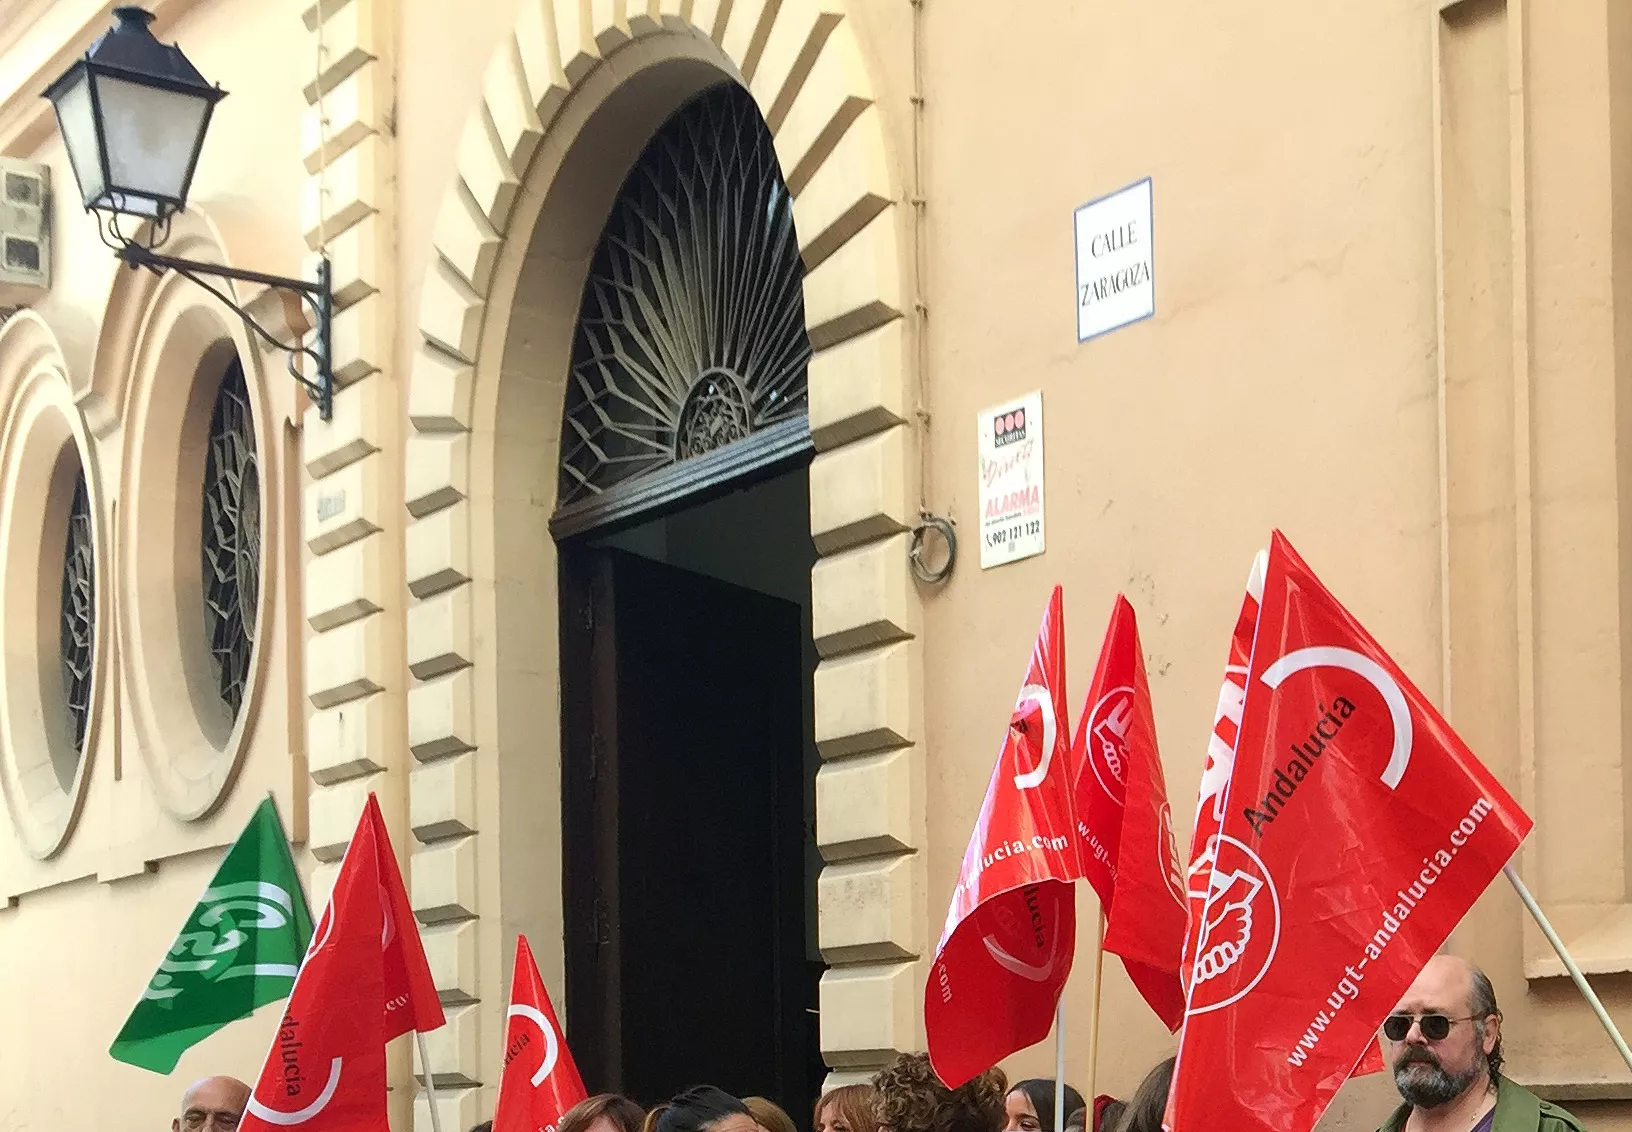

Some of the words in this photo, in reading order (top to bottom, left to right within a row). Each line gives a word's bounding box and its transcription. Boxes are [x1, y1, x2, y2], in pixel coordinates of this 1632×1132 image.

[1091, 220, 1138, 259] CALLE
[1080, 259, 1150, 307] ZARAGOZA
[986, 485, 1040, 519] ALARMA
[992, 531, 1007, 546] 902
[1009, 524, 1022, 541] 121
[1025, 519, 1040, 536] 122
[1242, 694, 1357, 838] Andalucía
[1286, 796, 1494, 1068] www.ugt-andalucia.com
